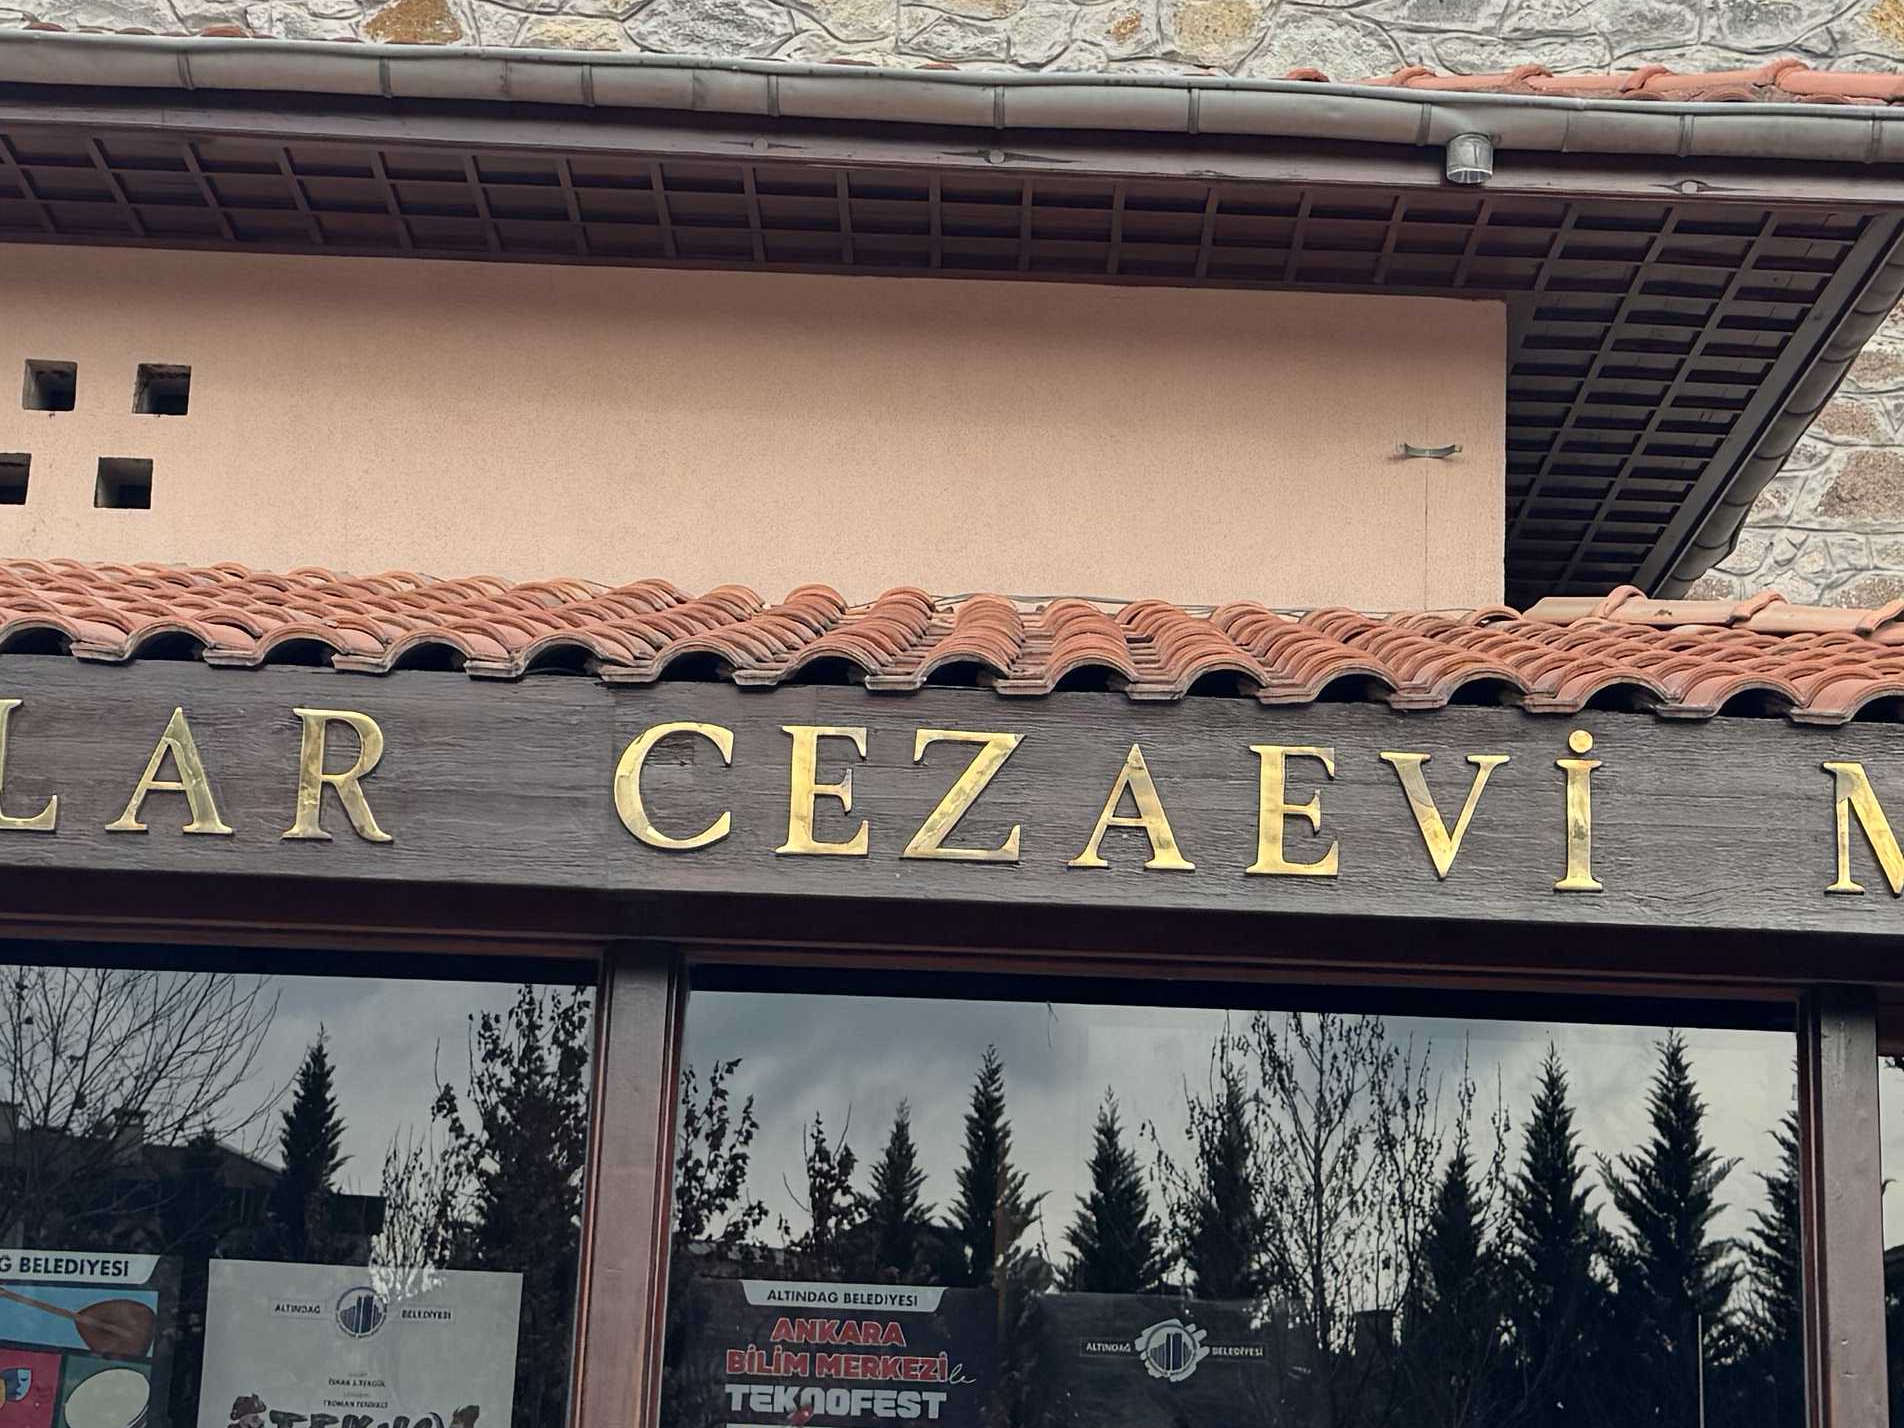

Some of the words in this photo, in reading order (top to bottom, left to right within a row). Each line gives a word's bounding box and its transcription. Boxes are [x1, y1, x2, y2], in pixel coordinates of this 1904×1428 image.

[613, 720, 1603, 892] CEZAEVİ
[770, 1317, 907, 1347] ANKARA
[726, 1343, 809, 1377] BİLİM
[815, 1351, 949, 1383] MERKEZİ
[725, 1384, 946, 1419] TEKNOFEST
